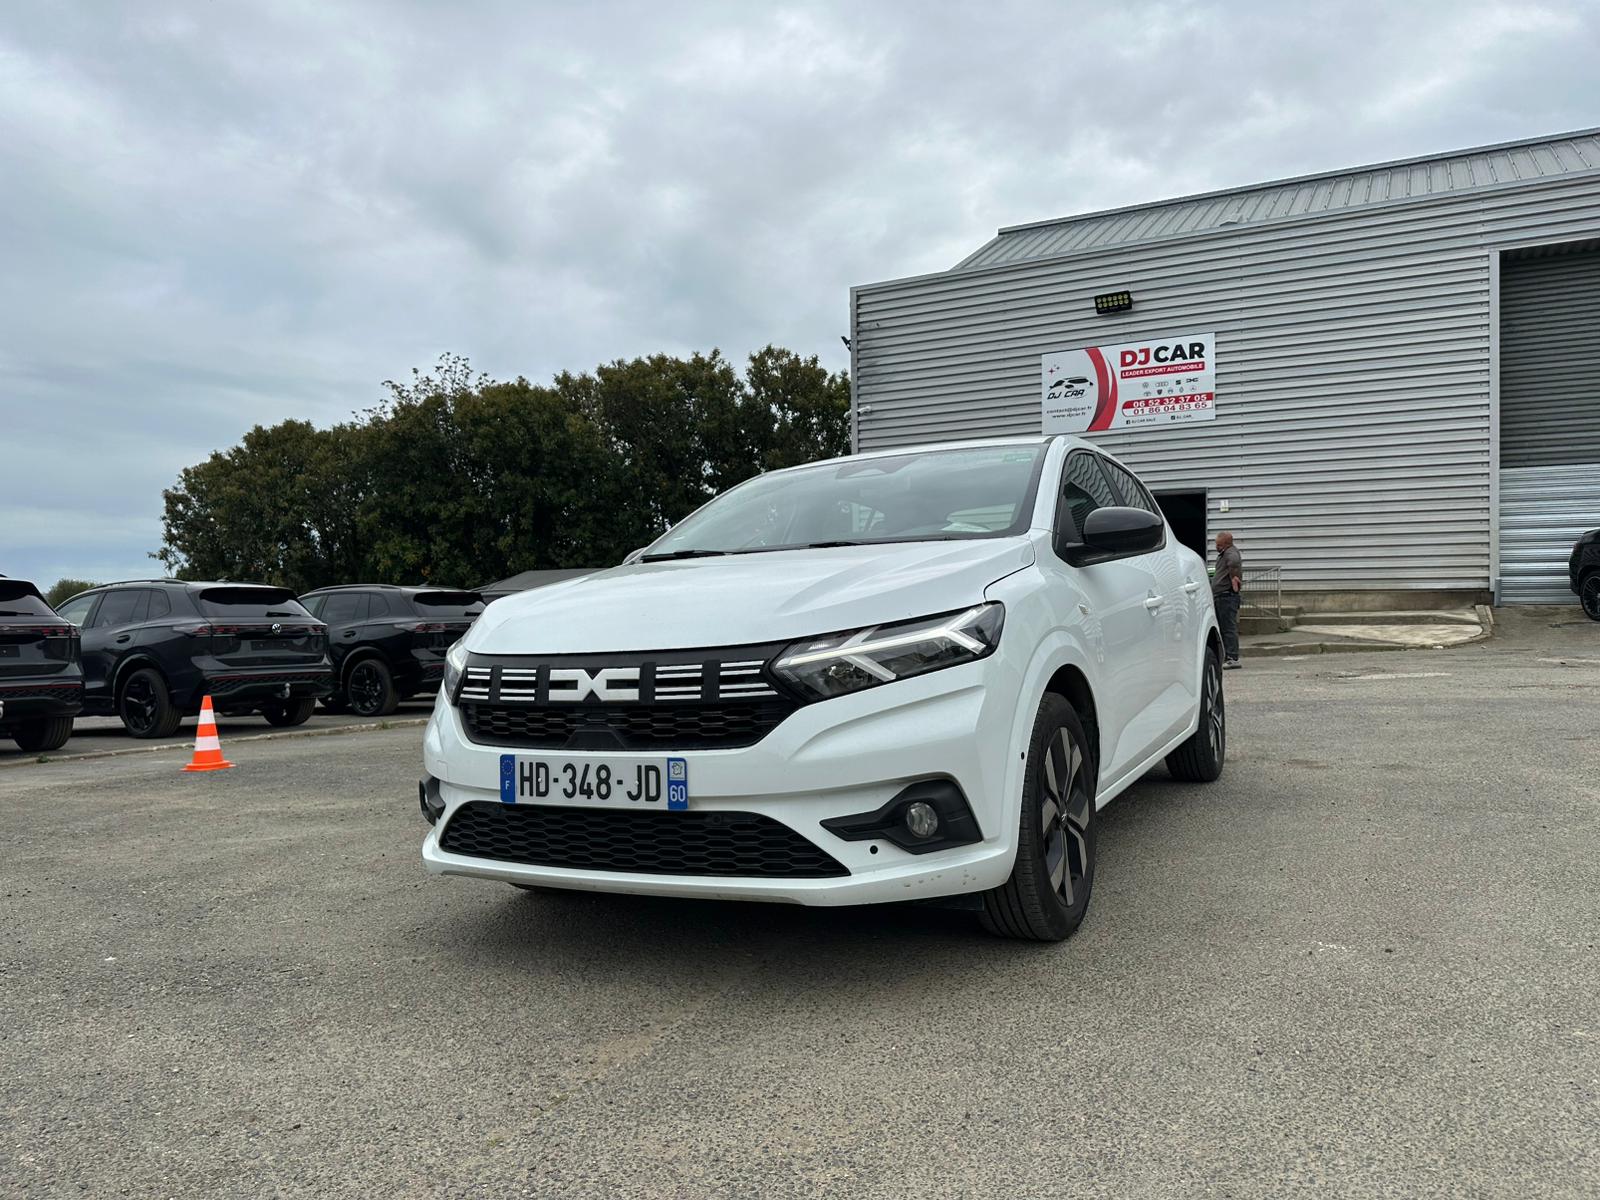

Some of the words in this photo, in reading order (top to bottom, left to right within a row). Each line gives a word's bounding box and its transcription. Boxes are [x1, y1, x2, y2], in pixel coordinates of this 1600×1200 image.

[1120, 348, 1150, 367] DJ
[1154, 342, 1205, 363] CAR
[1122, 369, 1144, 377] LEADER
[1145, 367, 1166, 375] EXPORT
[1166, 363, 1203, 372] AUTOMOBILE
[1047, 391, 1062, 400] DJ
[1064, 389, 1085, 398] CAR
[1194, 401, 1207, 409] 65
[505, 780, 510, 790] F
[519, 761, 662, 802] HD-348-JD
[669, 785, 686, 802] 60
